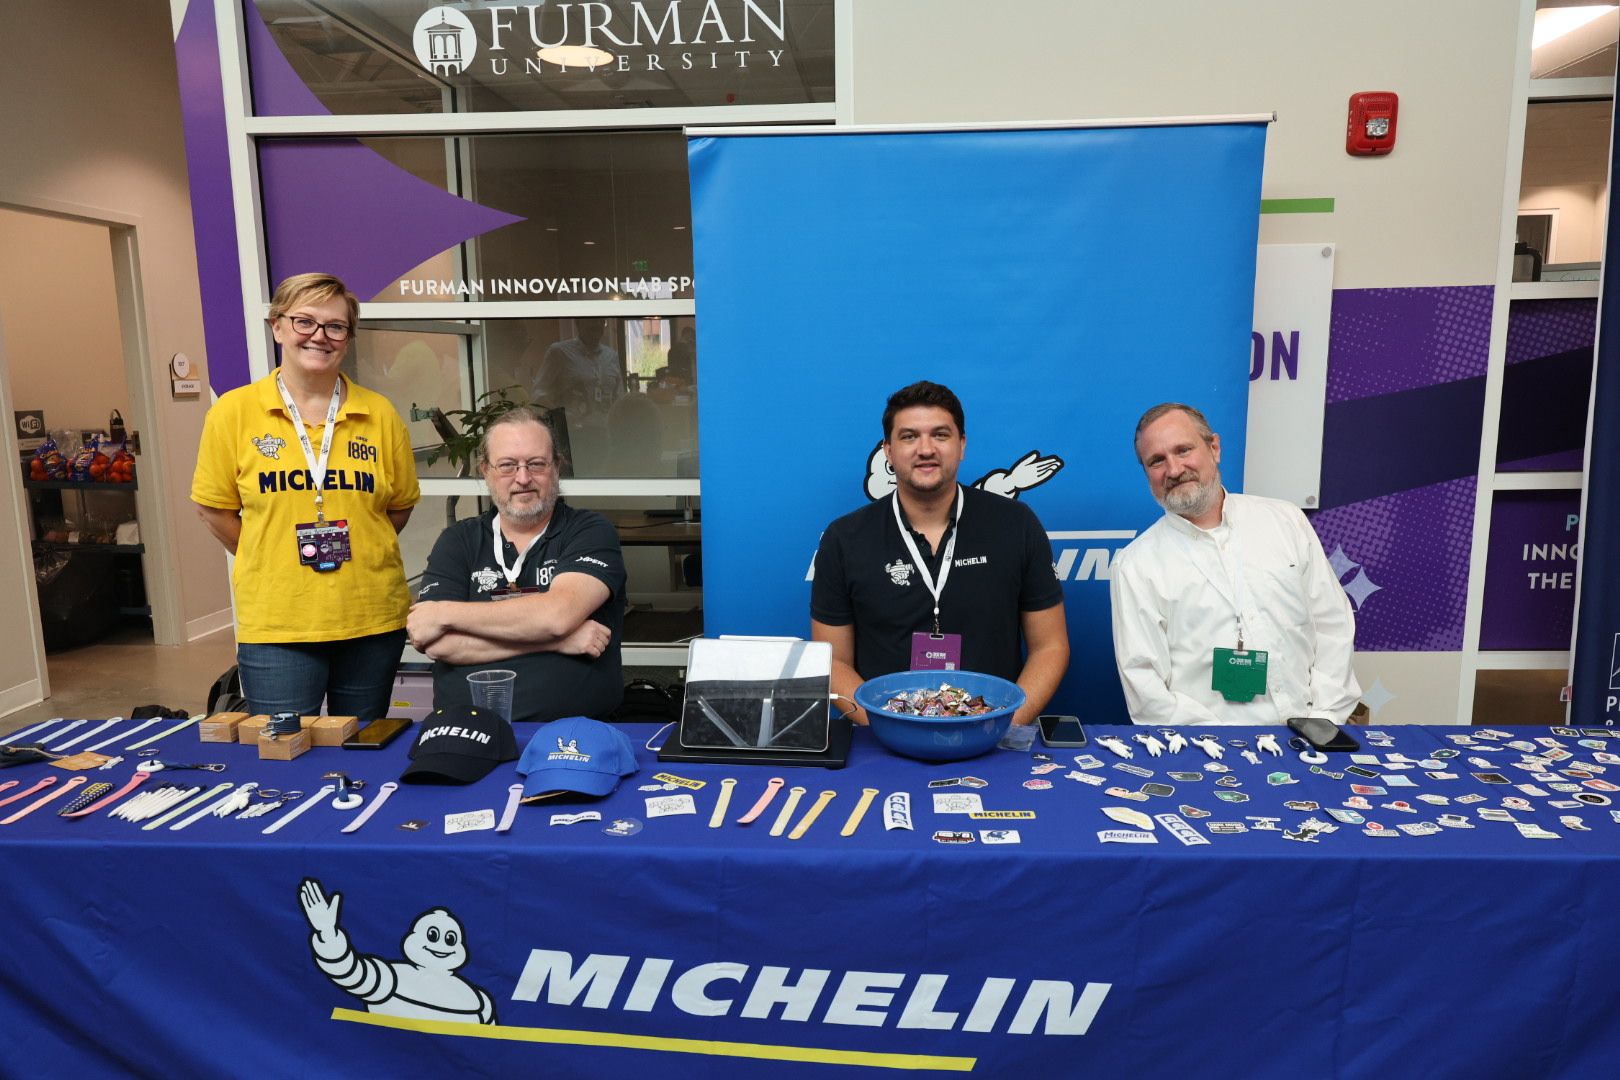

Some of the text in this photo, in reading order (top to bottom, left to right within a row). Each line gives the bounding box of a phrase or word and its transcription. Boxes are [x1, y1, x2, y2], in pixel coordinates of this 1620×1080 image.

[488, 0, 787, 50] FURMAN
[490, 49, 784, 76] UNIVERSITY
[400, 276, 695, 295] FURMAN INNOVATION LAB SP
[348, 440, 377, 463] 1889
[258, 468, 375, 494] MICHELIN
[954, 555, 987, 567] MICHELIN
[1527, 572, 1573, 590] THE
[418, 725, 491, 745] MICHELIN
[547, 754, 590, 763] MICHELIN
[657, 773, 702, 788] MICHELIN
[511, 948, 1113, 1036] MICHELIN
